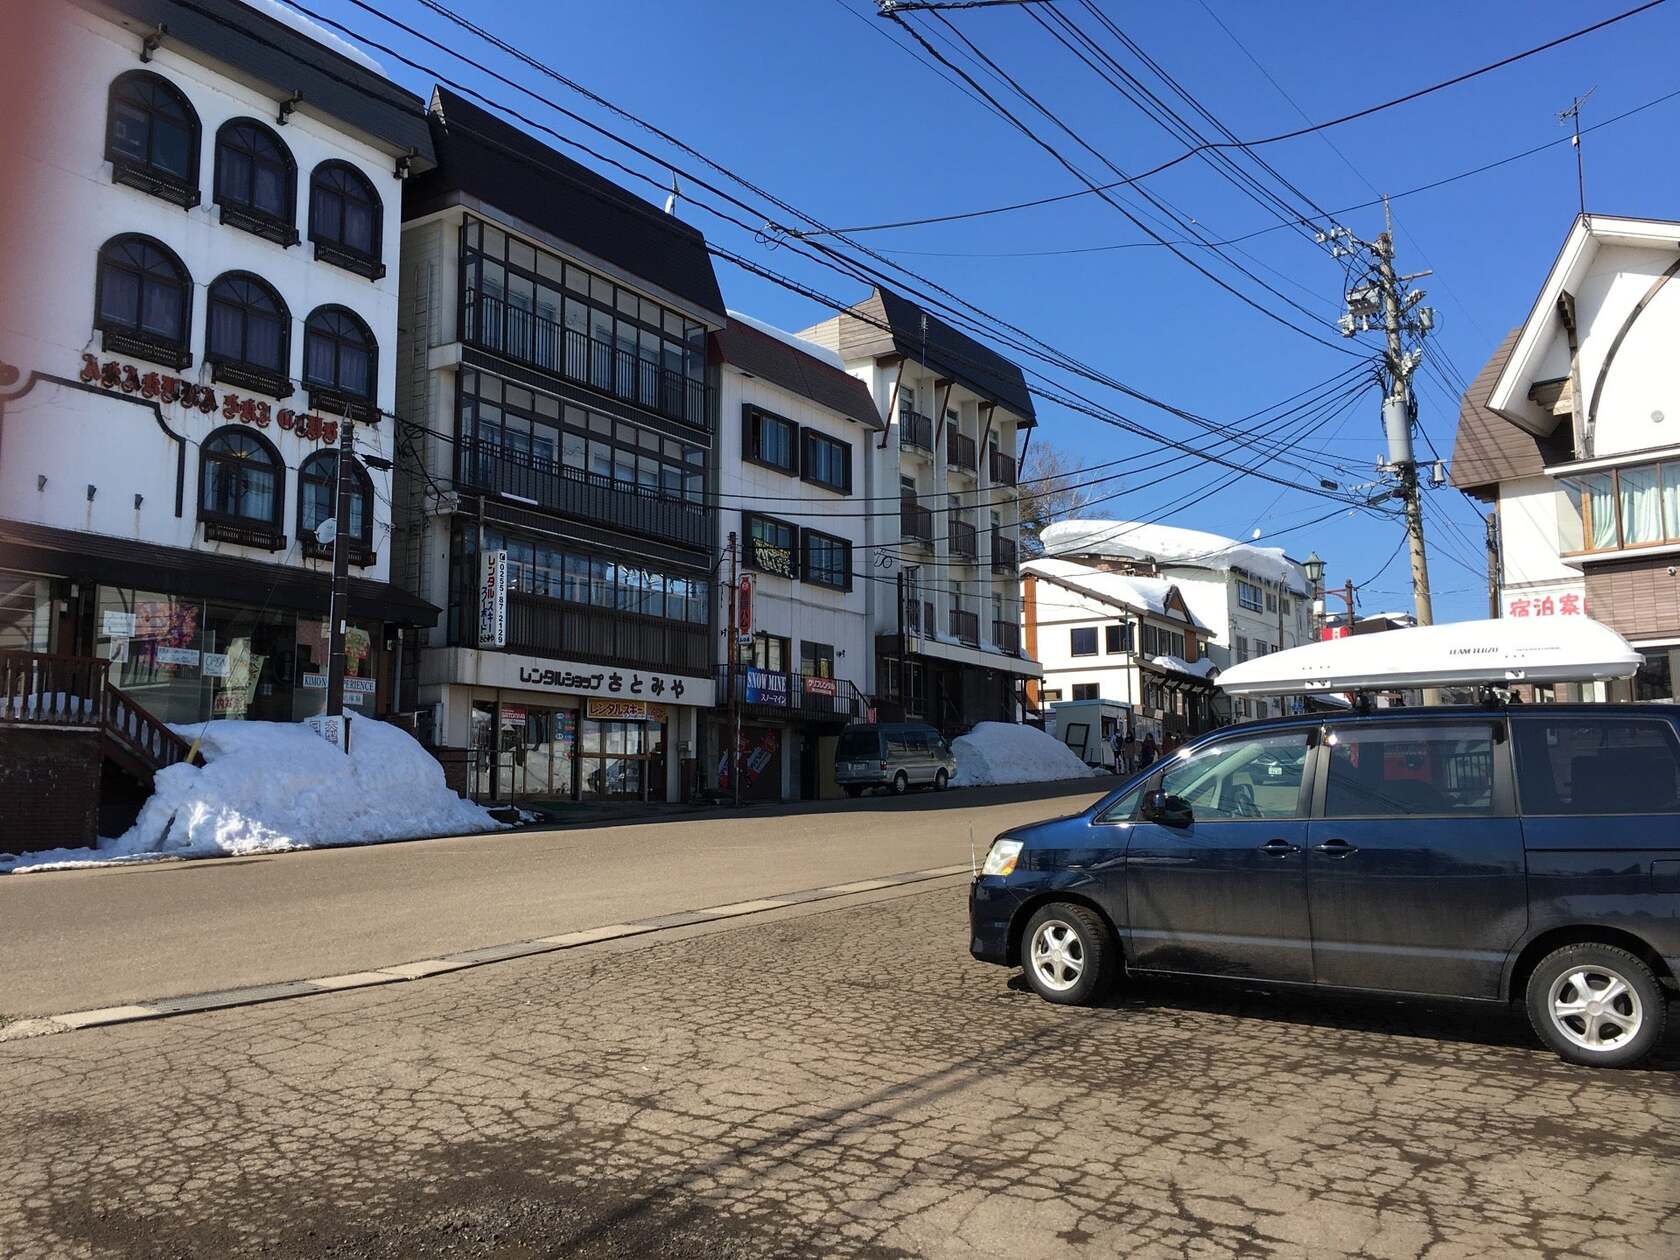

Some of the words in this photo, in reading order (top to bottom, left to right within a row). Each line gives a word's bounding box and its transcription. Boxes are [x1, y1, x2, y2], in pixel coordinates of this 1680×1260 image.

[79, 352, 219, 415] AKAKURA
[222, 394, 271, 429] SKI
[276, 408, 338, 445] CLUB
[487, 555, 496, 633] レンタルスキー
[1510, 593, 1590, 618] 宿泊案
[304, 676, 328, 687] KIMON
[519, 667, 605, 691] レンタルショップ
[608, 672, 685, 699] さとみや
[747, 671, 767, 689] SNOW
[768, 674, 786, 692] MINE
[590, 703, 644, 715] レンタルスキー
